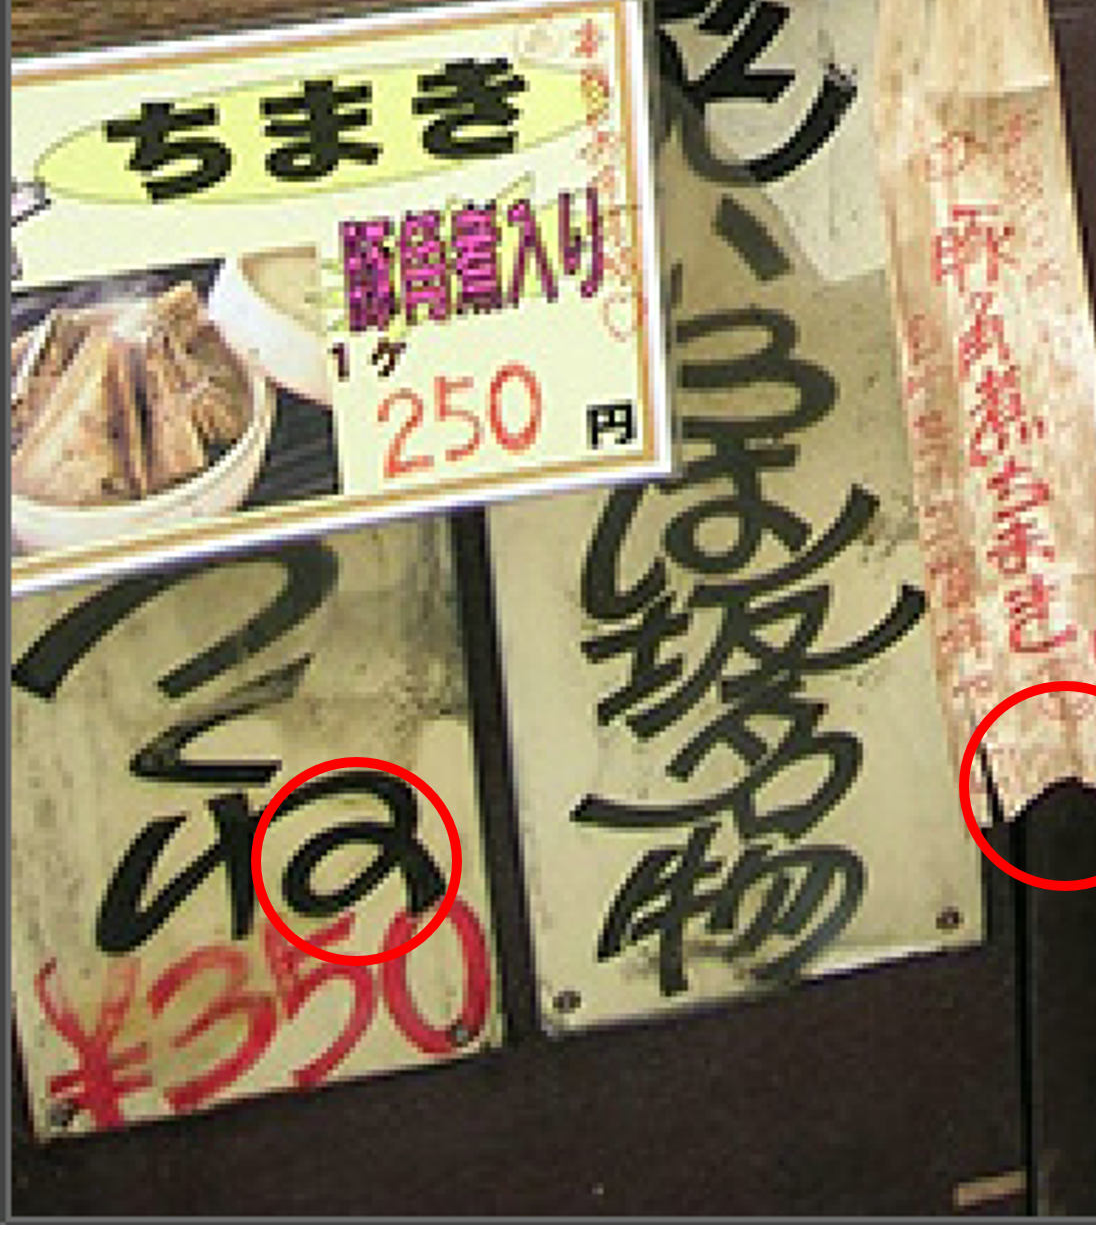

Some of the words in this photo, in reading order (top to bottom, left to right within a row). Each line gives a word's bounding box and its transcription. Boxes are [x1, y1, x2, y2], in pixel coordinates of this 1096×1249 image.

[104, 58, 528, 202] ちまき
[376, 364, 543, 479] 250
[585, 402, 637, 449] 円
